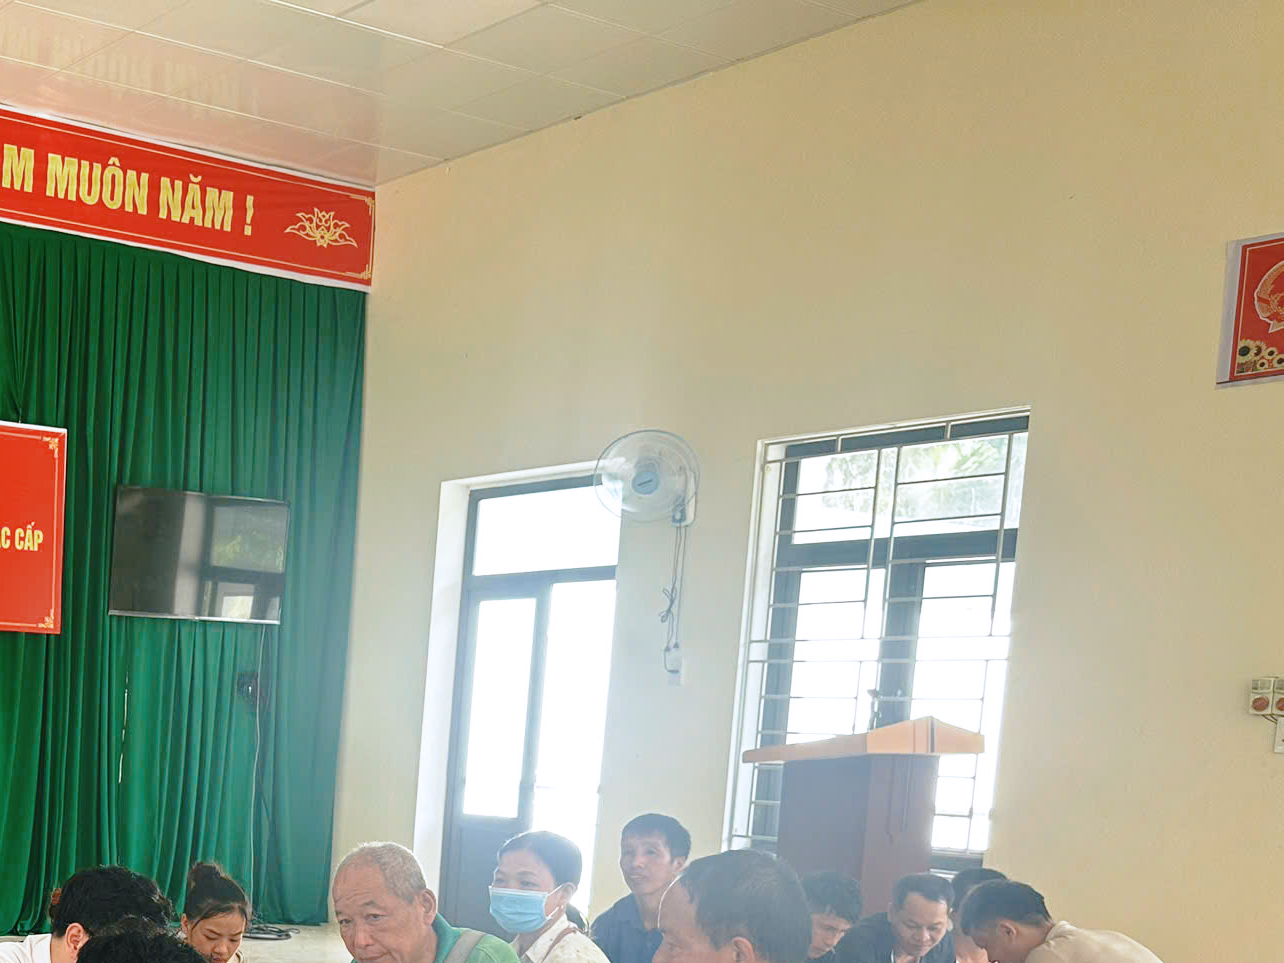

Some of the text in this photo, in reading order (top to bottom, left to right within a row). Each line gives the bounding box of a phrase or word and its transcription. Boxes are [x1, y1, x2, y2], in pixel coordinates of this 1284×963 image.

[45, 152, 150, 216] MUÔN
[158, 175, 234, 232] NĂM
[14, 521, 44, 552] CẤP
